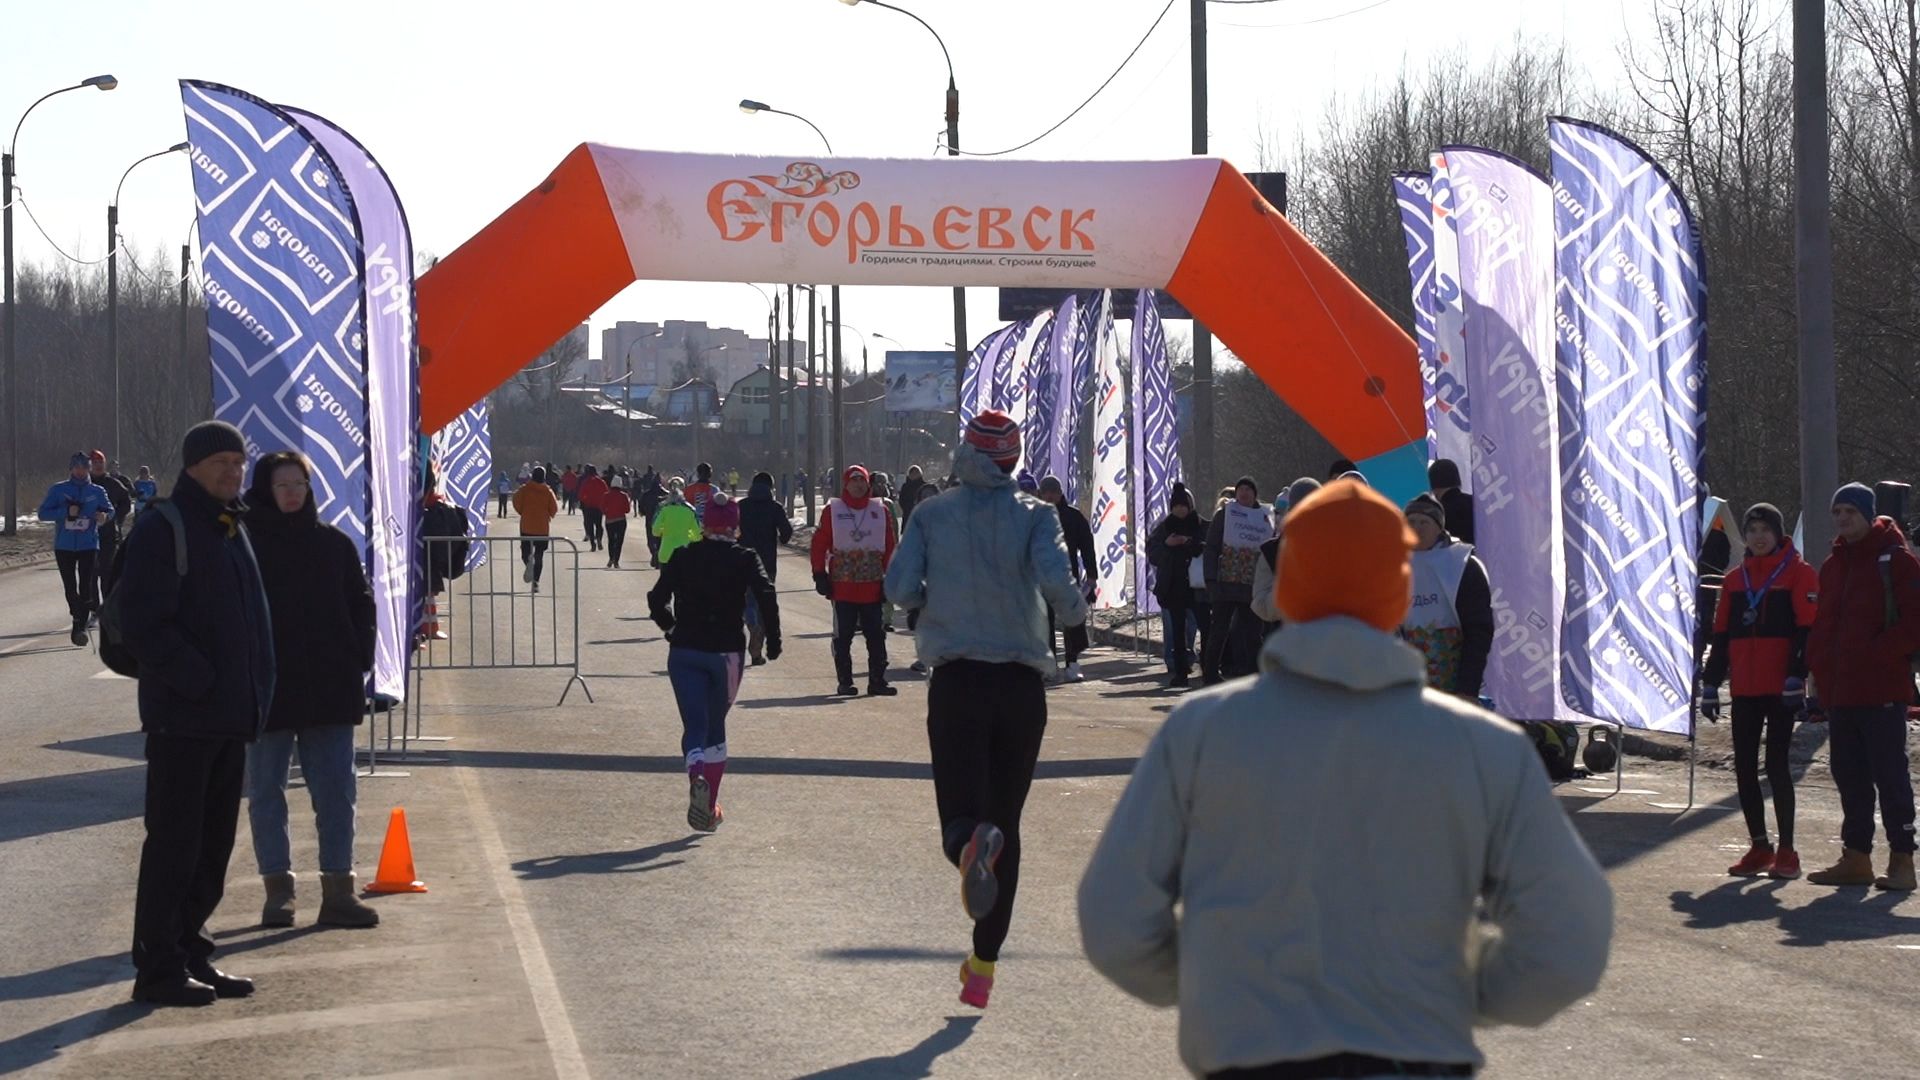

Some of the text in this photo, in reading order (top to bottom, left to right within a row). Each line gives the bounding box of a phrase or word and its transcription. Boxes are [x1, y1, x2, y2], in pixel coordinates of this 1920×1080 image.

[861, 253, 1097, 269] Гордимся традициями. Строим будущее
[1097, 412, 1126, 463] sen
[1091, 485, 1111, 534] eni
[1099, 526, 1127, 579] sen
